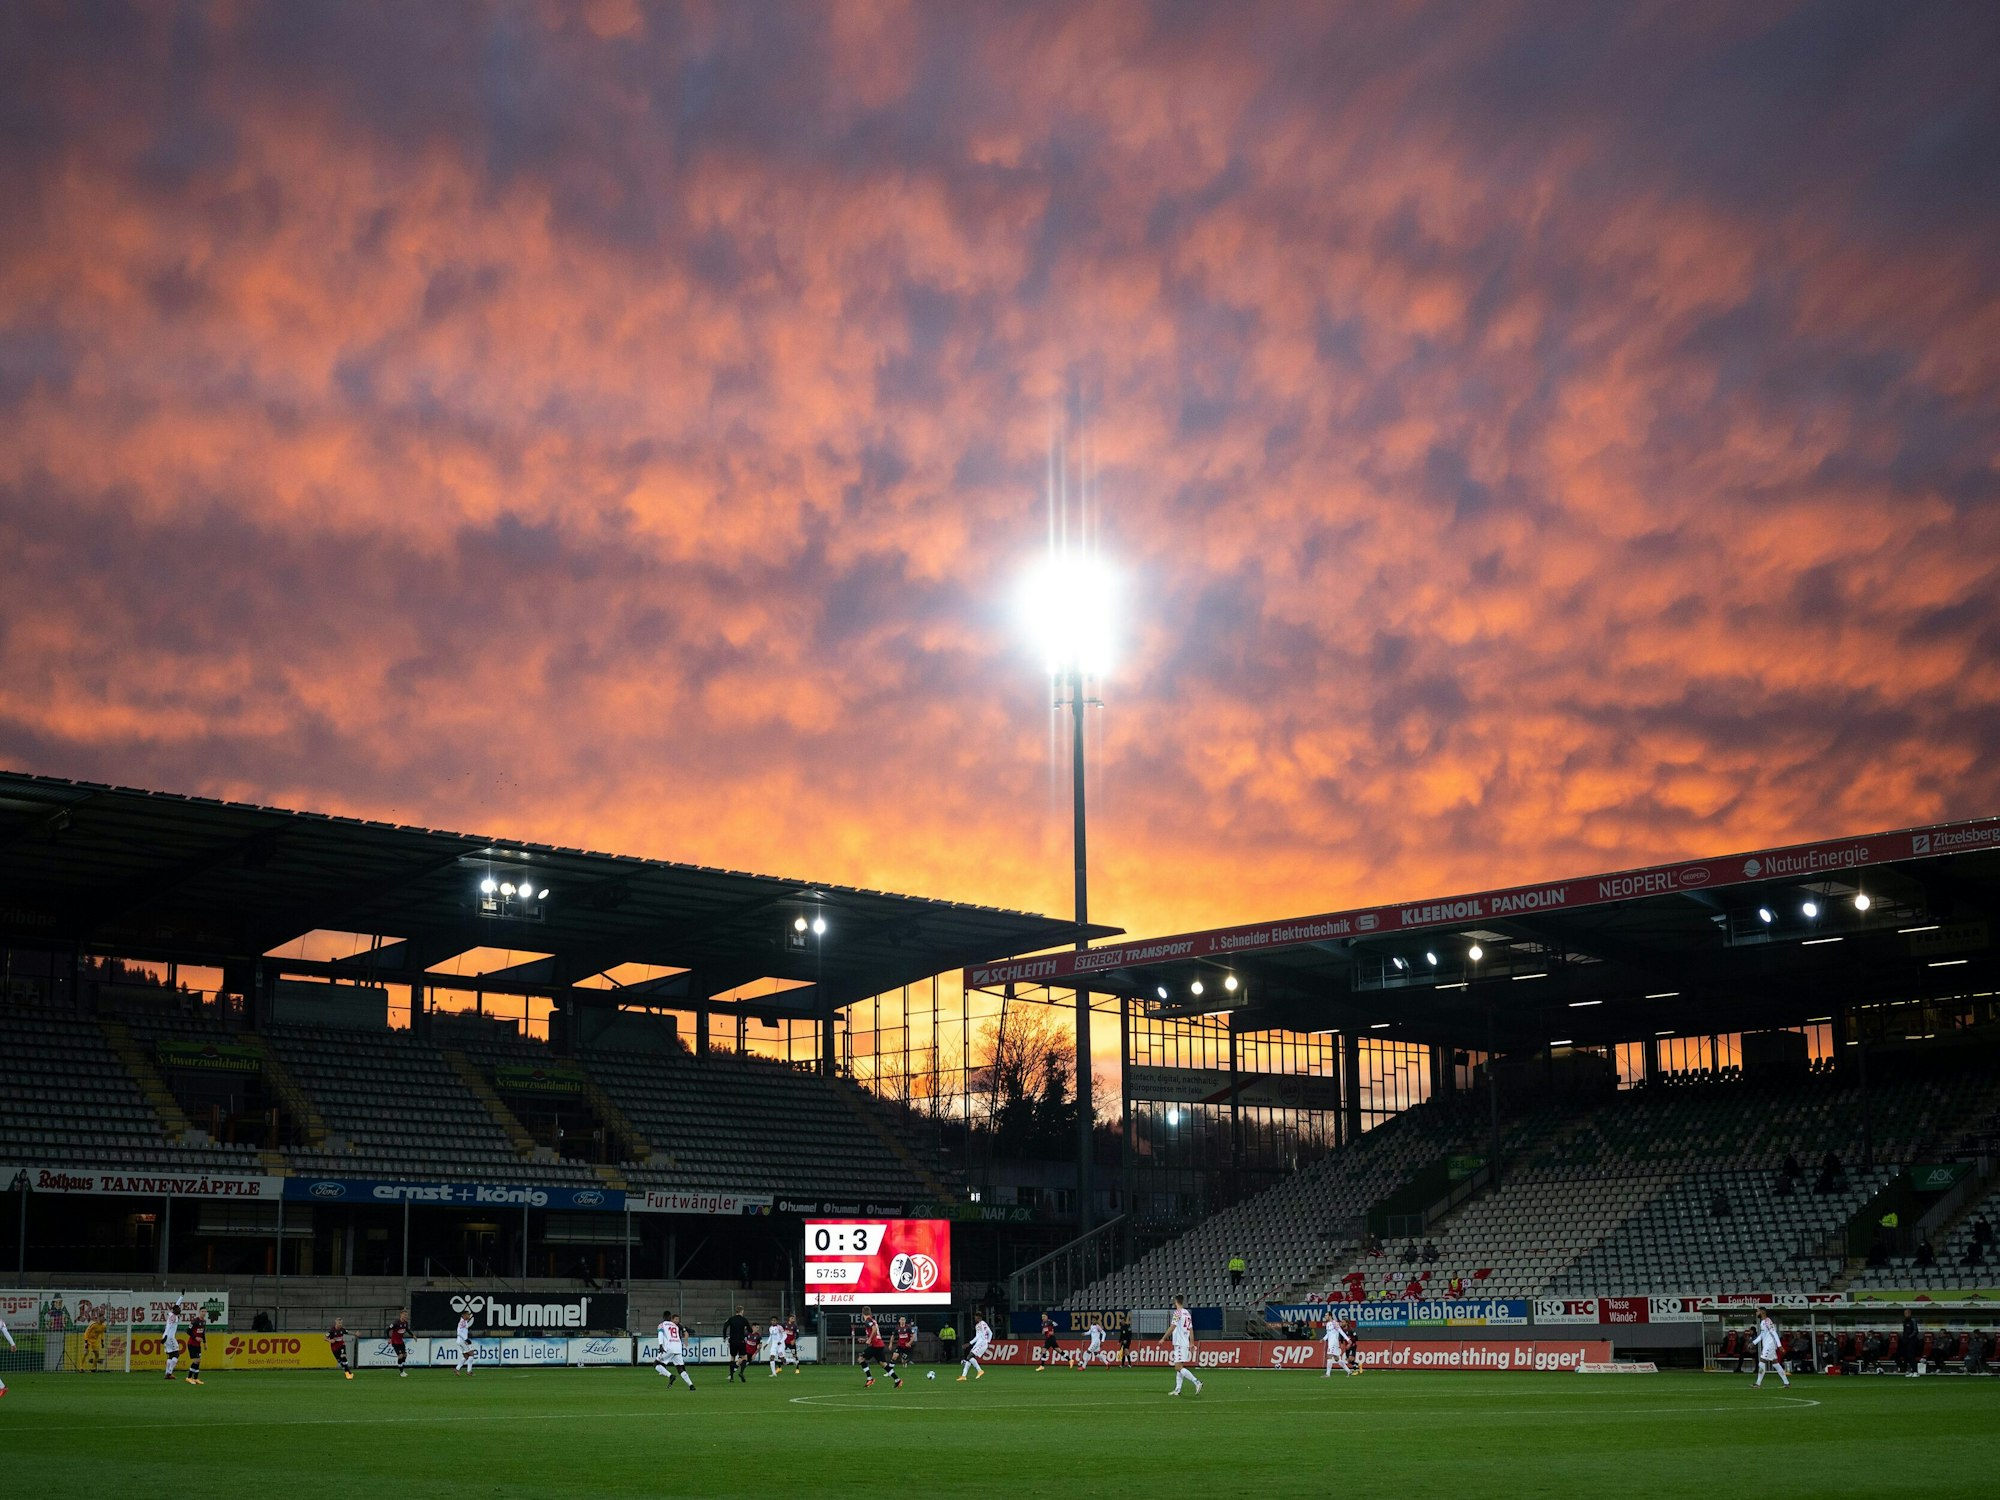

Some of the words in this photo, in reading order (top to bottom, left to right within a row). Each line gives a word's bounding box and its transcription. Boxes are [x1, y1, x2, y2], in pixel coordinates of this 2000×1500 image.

[1765, 845, 1869, 875] NaturEnergie
[1402, 901, 1483, 925] KLEENOIL
[1492, 889, 1566, 913] PANOLIN
[1209, 938, 1219, 951] J.
[1220, 931, 1270, 950] Schneider
[1271, 920, 1351, 942] Elektrotechnik
[1077, 953, 1121, 968] STRECK
[1126, 941, 1194, 961] TRANSPORT
[989, 960, 1057, 982] SCHLEITH
[158, 1053, 260, 1071] Schwarzwaldmilch
[37, 1170, 94, 1192] Rothaus
[101, 1176, 260, 1196] TANNENZÄPFLE
[1926, 1168, 1955, 1182] AOK
[315, 1184, 340, 1196] Ford
[476, 1185, 548, 1207] könig
[578, 1192, 600, 1204] Ford
[647, 1193, 739, 1213] Furtwängler
[787, 1201, 817, 1213] hummel
[831, 1203, 860, 1215] hummel
[873, 1204, 902, 1216] hummel
[909, 1204, 934, 1218] AOK
[1009, 1207, 1032, 1221] AOK
[816, 1269, 847, 1279] 57:53
[487, 1296, 588, 1328] hummel
[1279, 1299, 1510, 1323] www.ketterer-liebherr.de
[1608, 1299, 1630, 1310] Nasse
[1609, 1312, 1638, 1323] Wände?
[249, 1338, 301, 1354] LOTTO
[436, 1346, 458, 1359] Am
[523, 1344, 563, 1359] Lieler.
[582, 1340, 618, 1355] Lieler
[982, 1344, 1018, 1361] SMP
[1270, 1345, 1313, 1365] SMP
[1392, 1347, 1411, 1365] of
[1413, 1347, 1510, 1370] something
